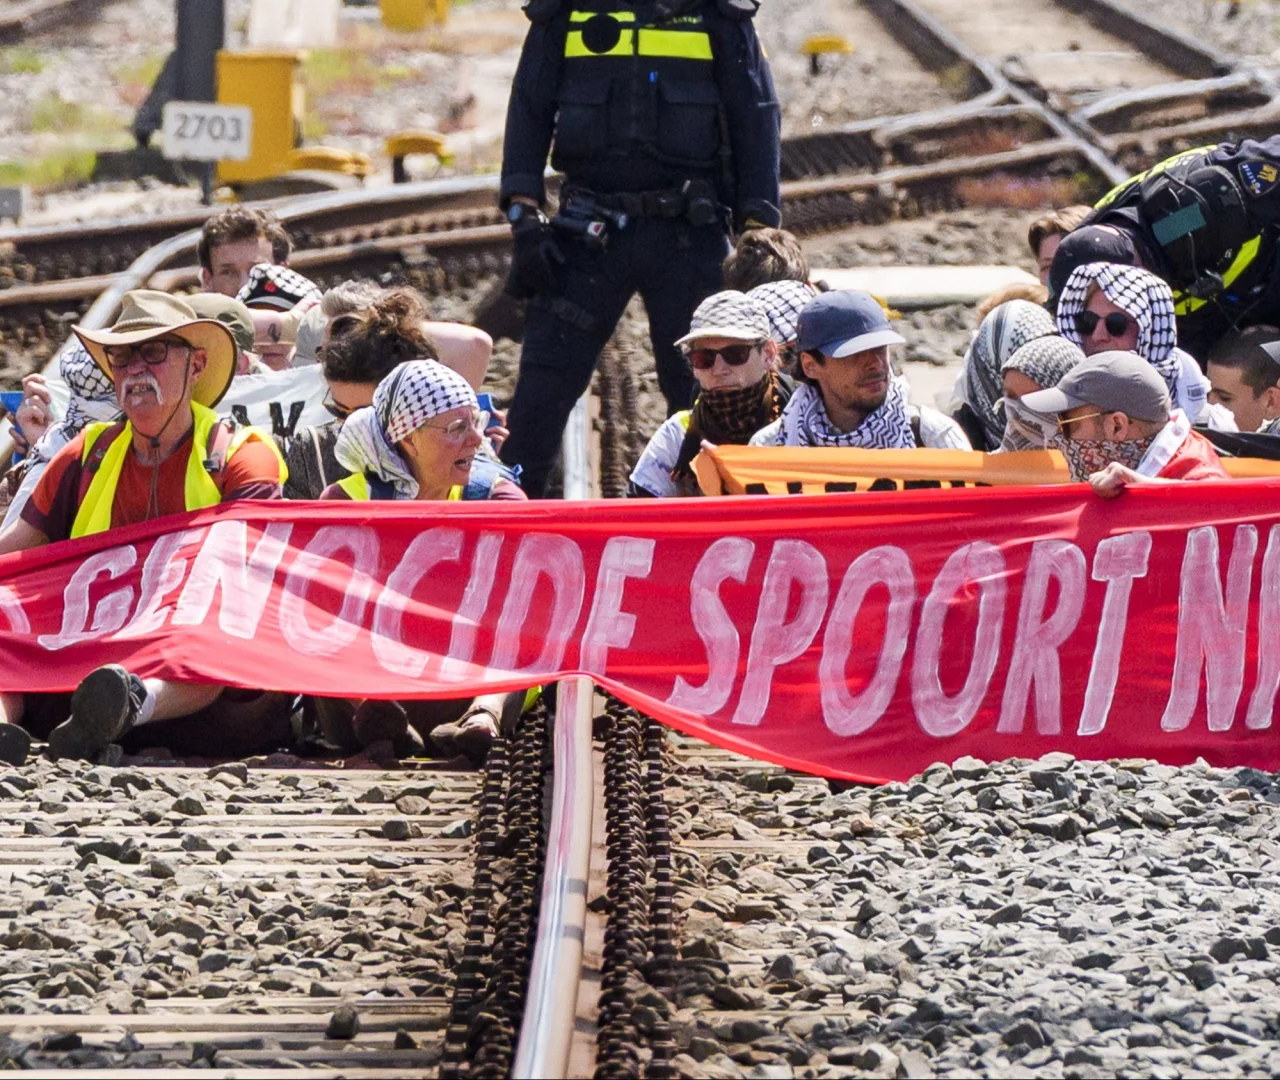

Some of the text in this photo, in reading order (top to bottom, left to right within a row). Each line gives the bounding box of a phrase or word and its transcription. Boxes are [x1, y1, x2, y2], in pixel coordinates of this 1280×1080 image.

[174, 114, 242, 141] 2703
[1242, 164, 1261, 194] POLITIE
[37, 520, 656, 682] GENOCIDE
[666, 531, 1152, 738] SPOORT
